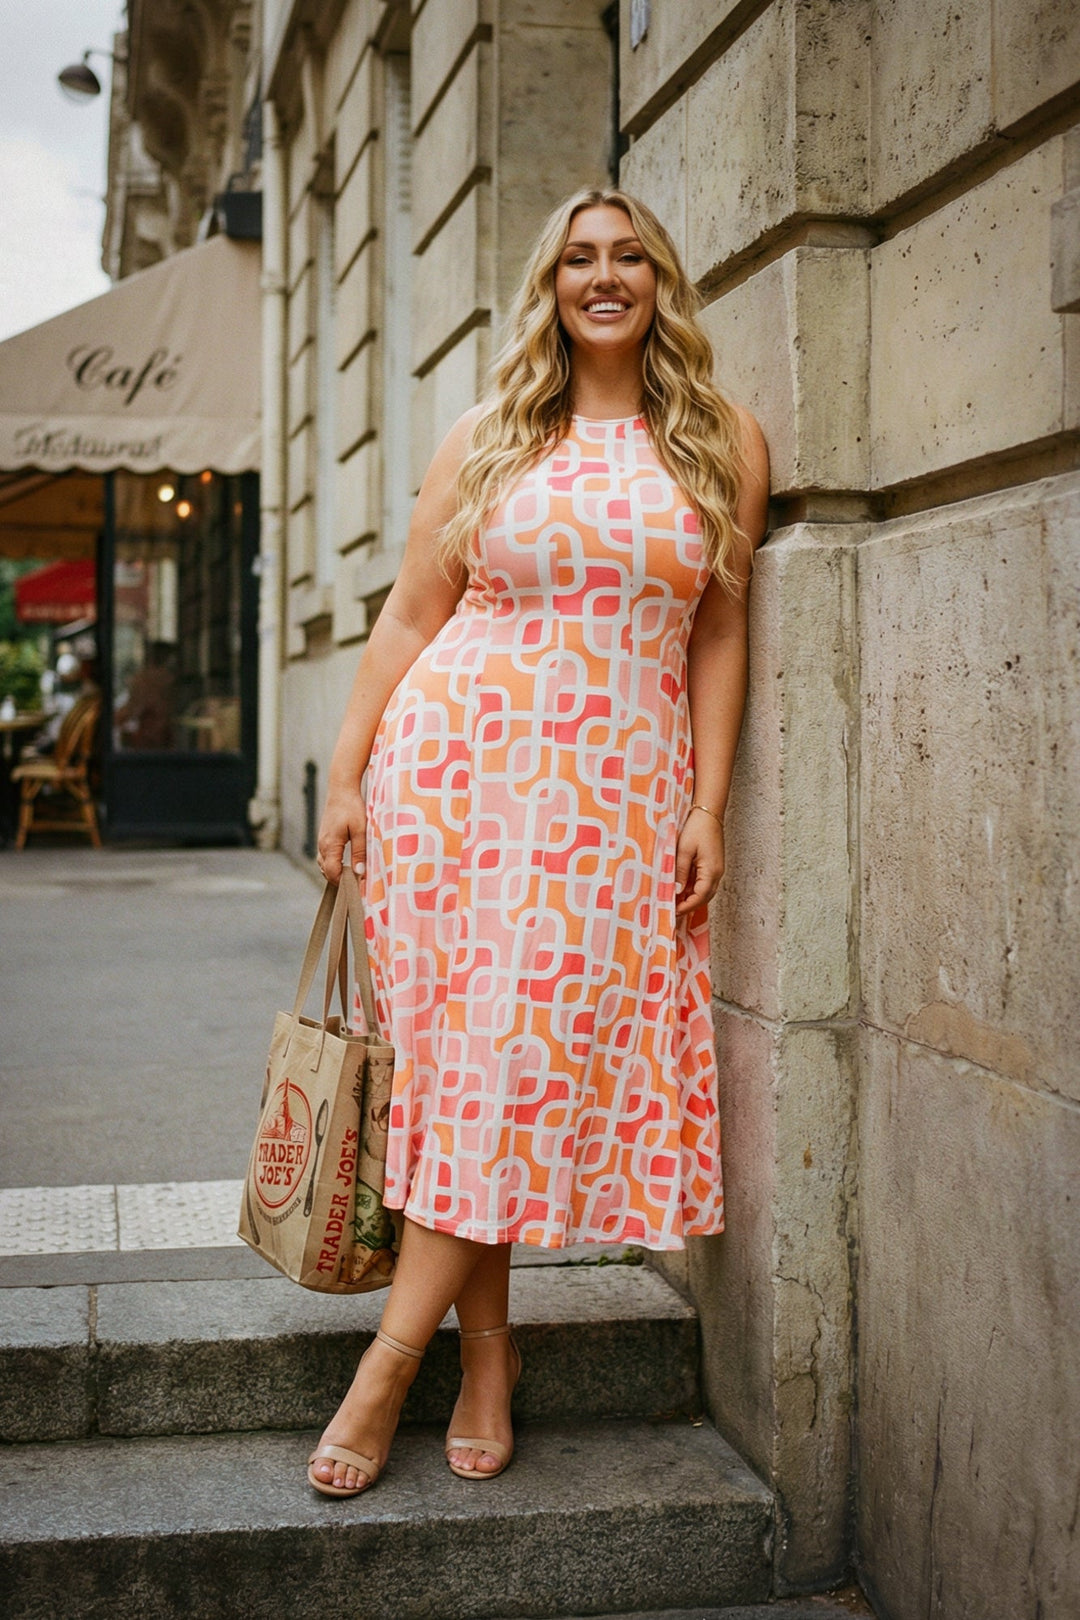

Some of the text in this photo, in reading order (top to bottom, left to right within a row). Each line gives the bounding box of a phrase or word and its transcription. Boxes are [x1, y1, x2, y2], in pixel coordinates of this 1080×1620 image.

[66, 344, 183, 407] Café
[258, 1143, 304, 1165] TRADER
[259, 1165, 295, 1186] JOE'S
[316, 1193, 349, 1274] TRADER
[335, 1127, 358, 1187] JOE'S
